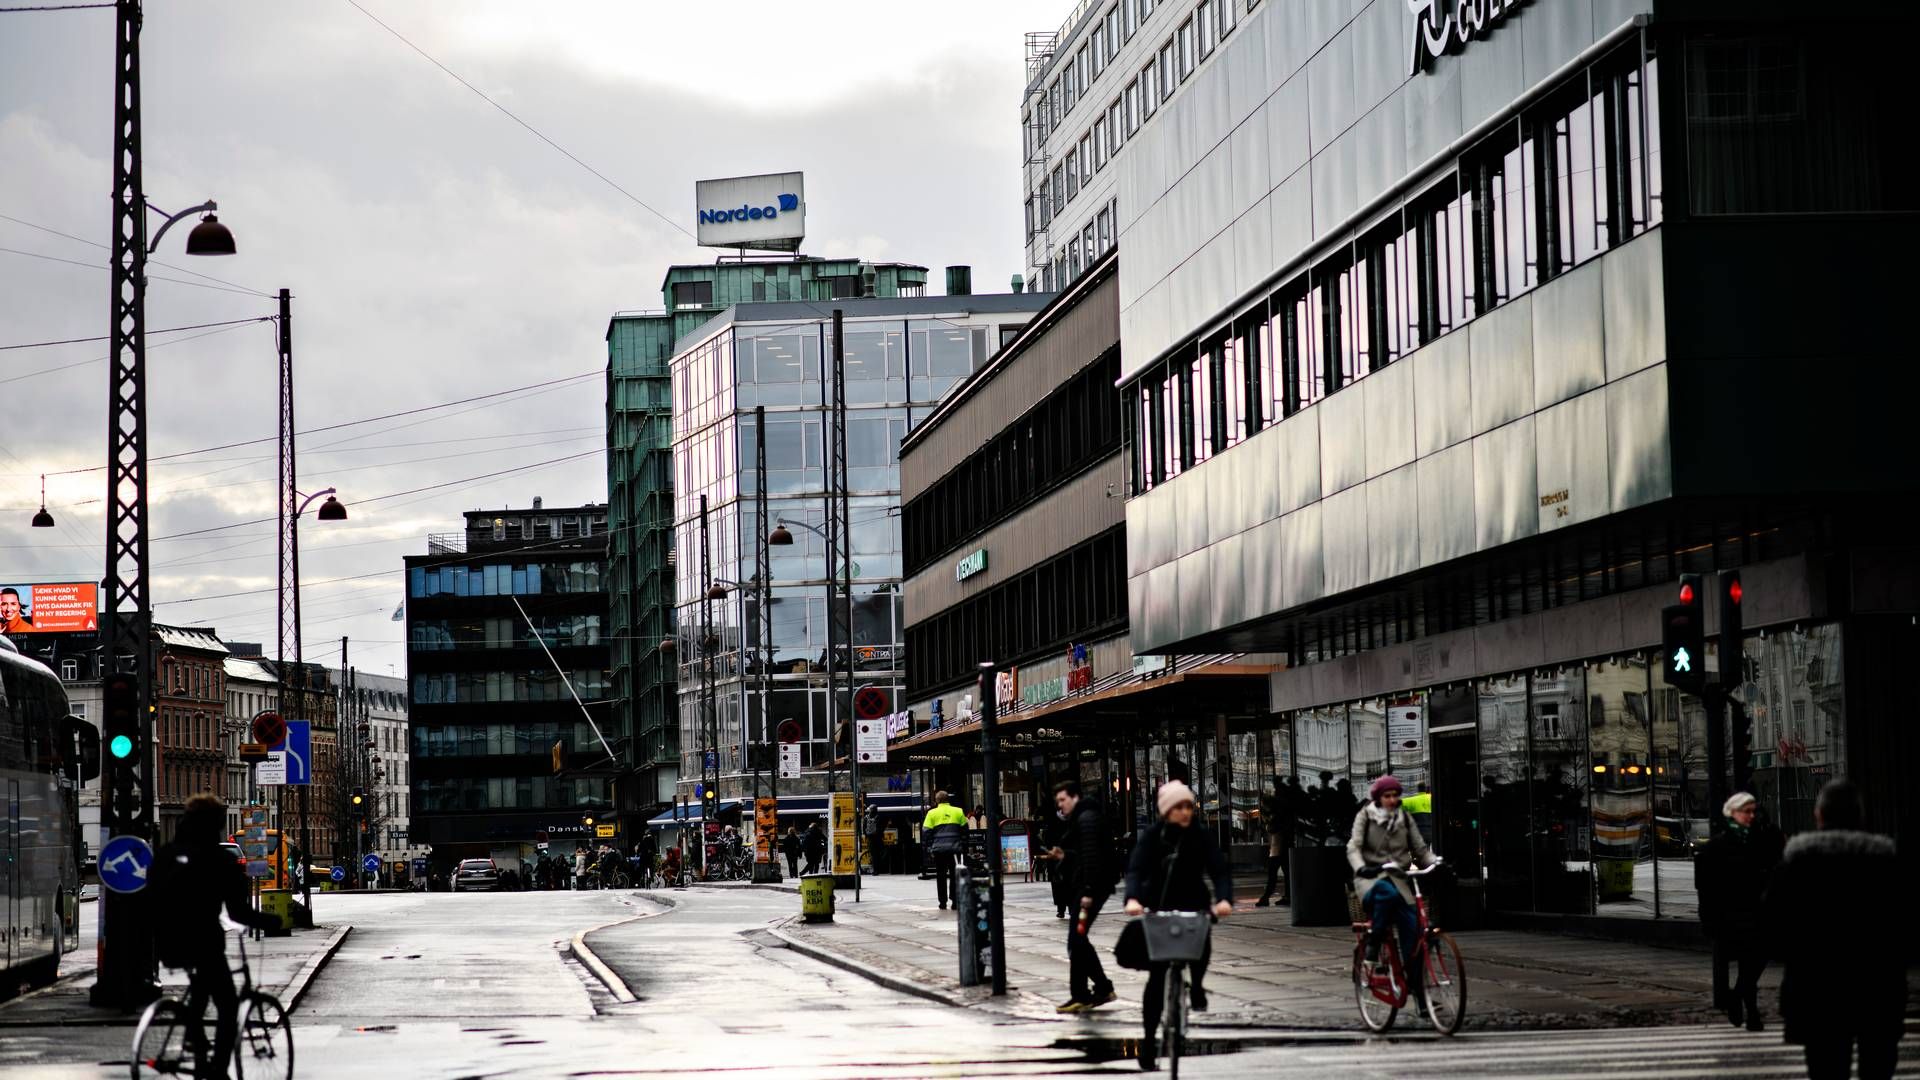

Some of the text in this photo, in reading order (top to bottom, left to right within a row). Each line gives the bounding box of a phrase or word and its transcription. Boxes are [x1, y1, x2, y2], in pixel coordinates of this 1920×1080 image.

[700, 205, 777, 225] Nordea
[87, 619, 95, 628] A
[806, 889, 823, 897] REN
[806, 897, 823, 905] KBH
